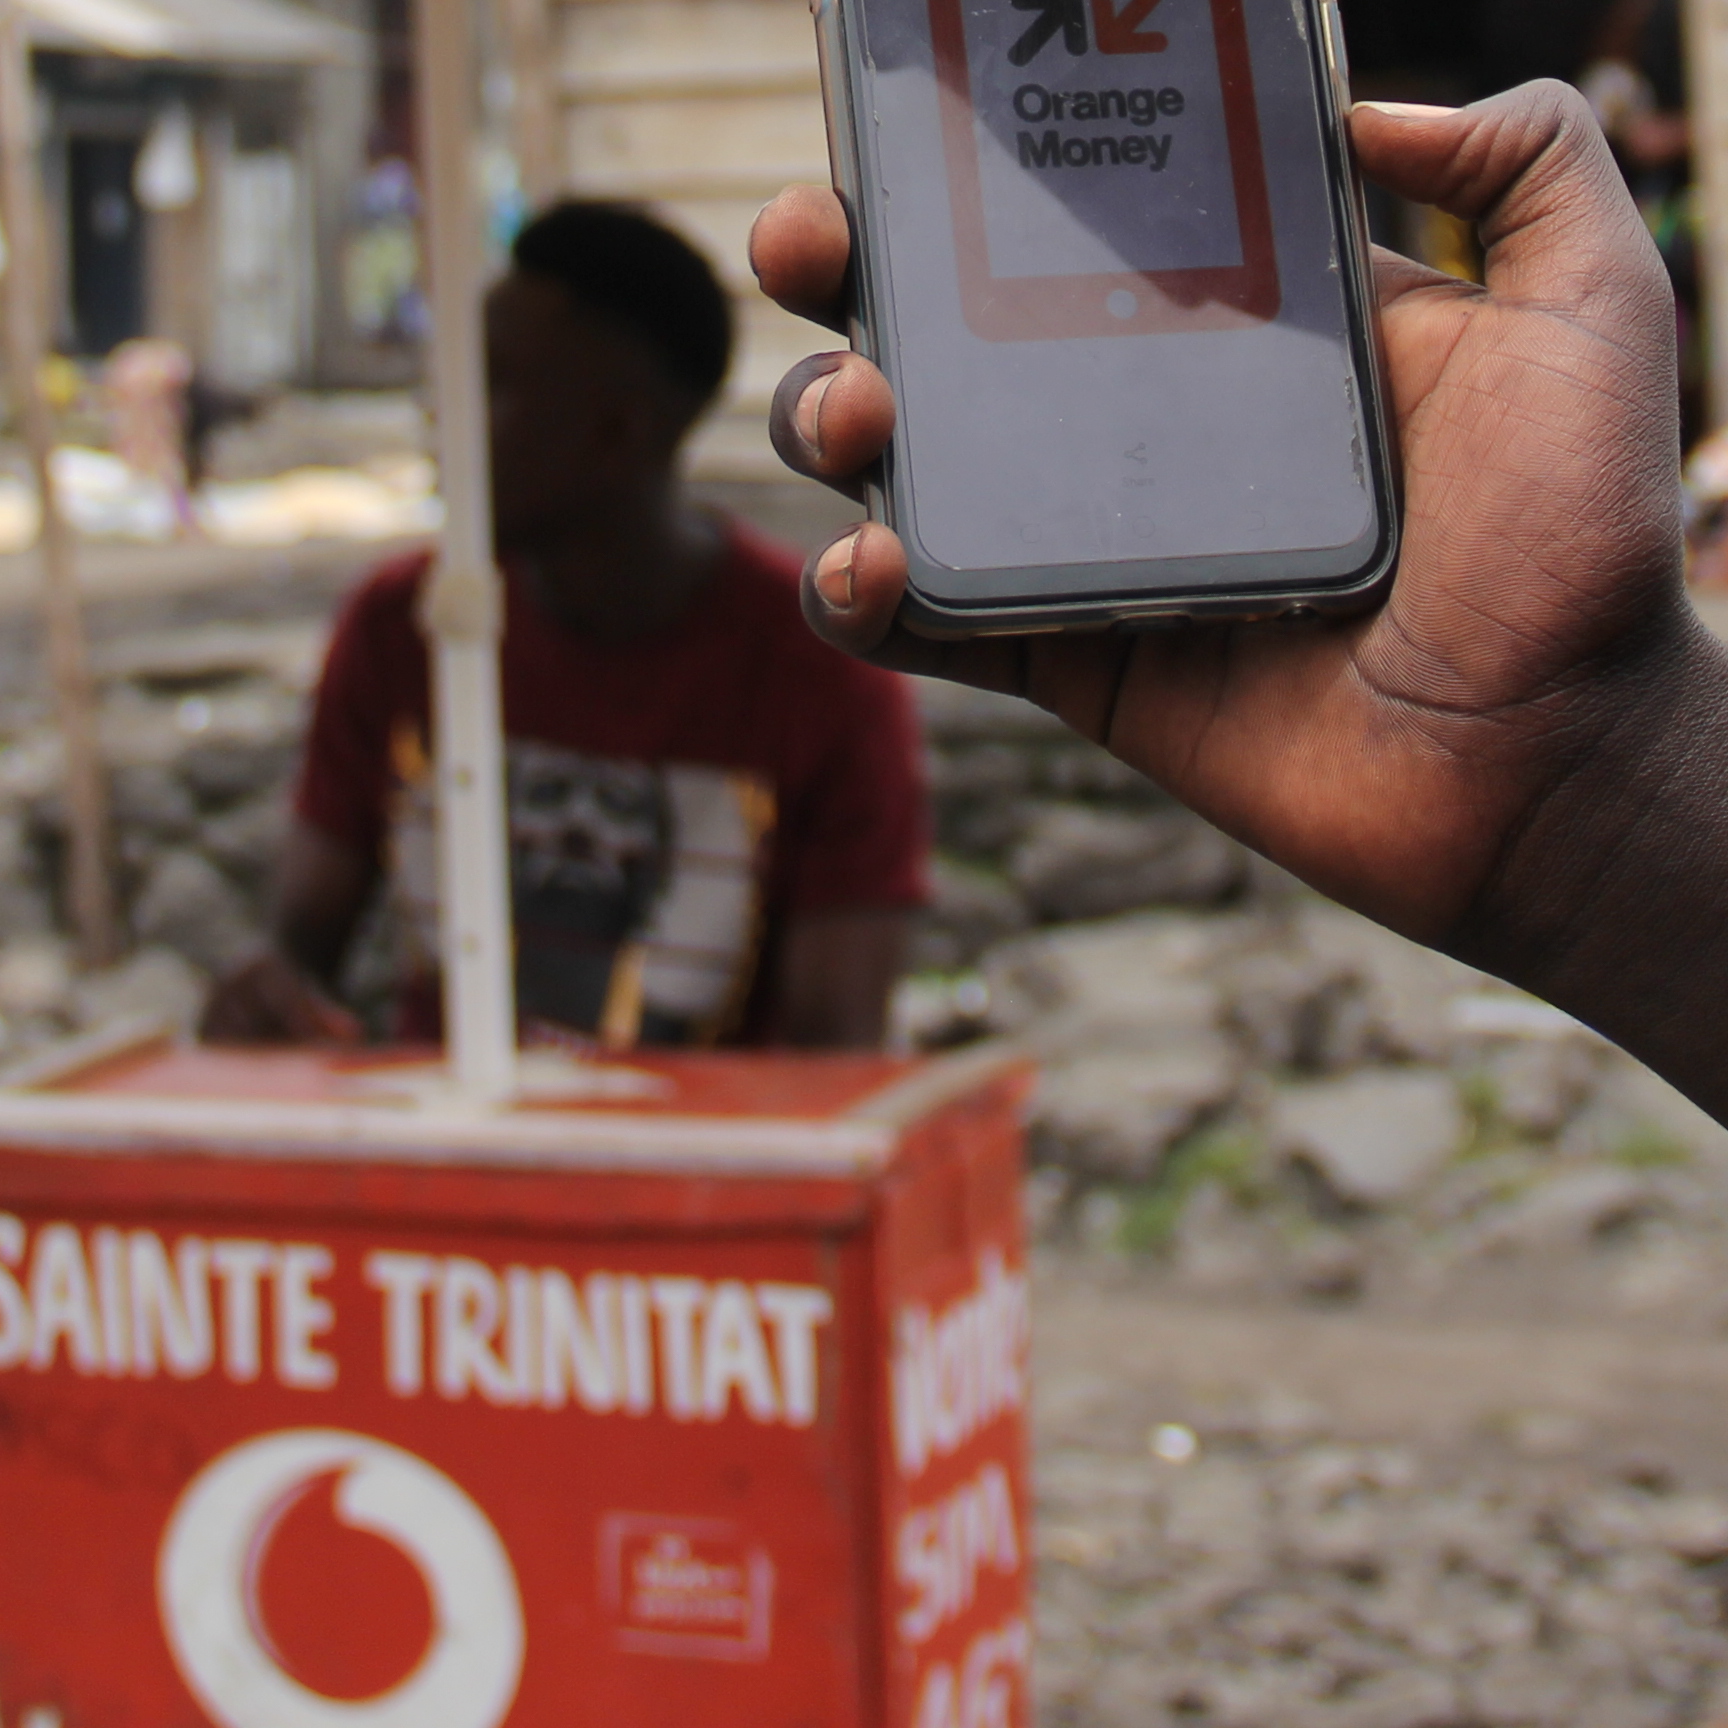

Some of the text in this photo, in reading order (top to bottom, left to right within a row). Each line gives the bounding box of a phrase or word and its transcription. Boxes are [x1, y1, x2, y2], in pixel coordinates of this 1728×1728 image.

[1013, 84, 1185, 127] Orange
[1017, 130, 1172, 172] Money
[364, 1247, 834, 1429] TRINITAT
